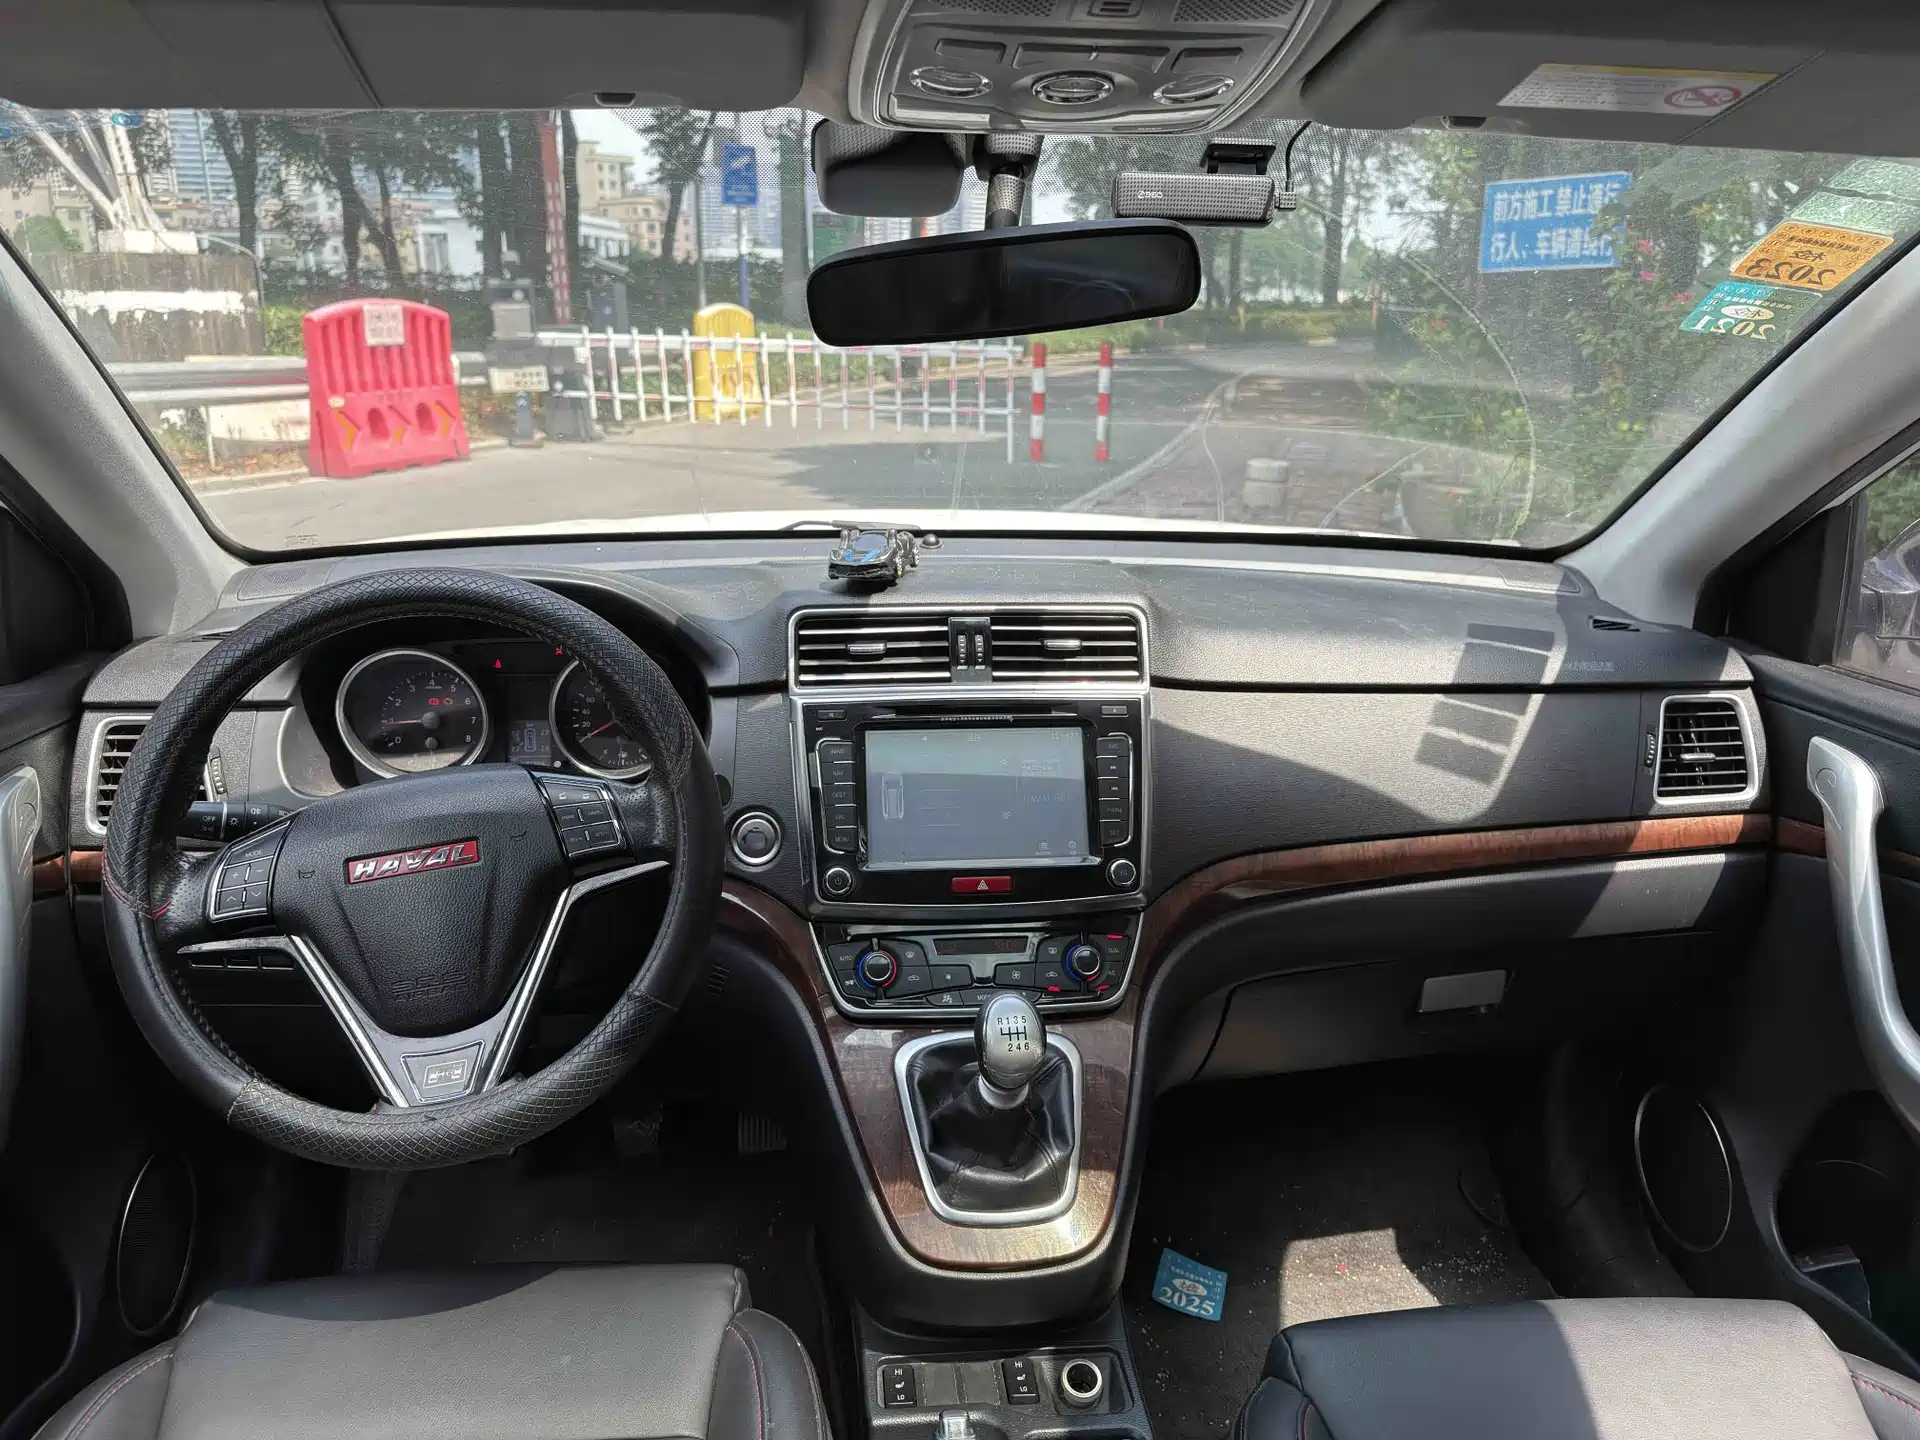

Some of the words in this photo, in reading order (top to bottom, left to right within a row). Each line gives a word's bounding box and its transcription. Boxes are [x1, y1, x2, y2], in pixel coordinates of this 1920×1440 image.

[353, 844, 474, 880] HAVAL
[997, 1017, 1003, 1025] R
[1013, 1015, 1018, 1024] 3
[1021, 1015, 1027, 1023] 5
[1008, 1043, 1013, 1051] 2
[1016, 1043, 1021, 1051] 4
[1024, 1042, 1030, 1050] 6
[1157, 1286, 1215, 1316] 2025
